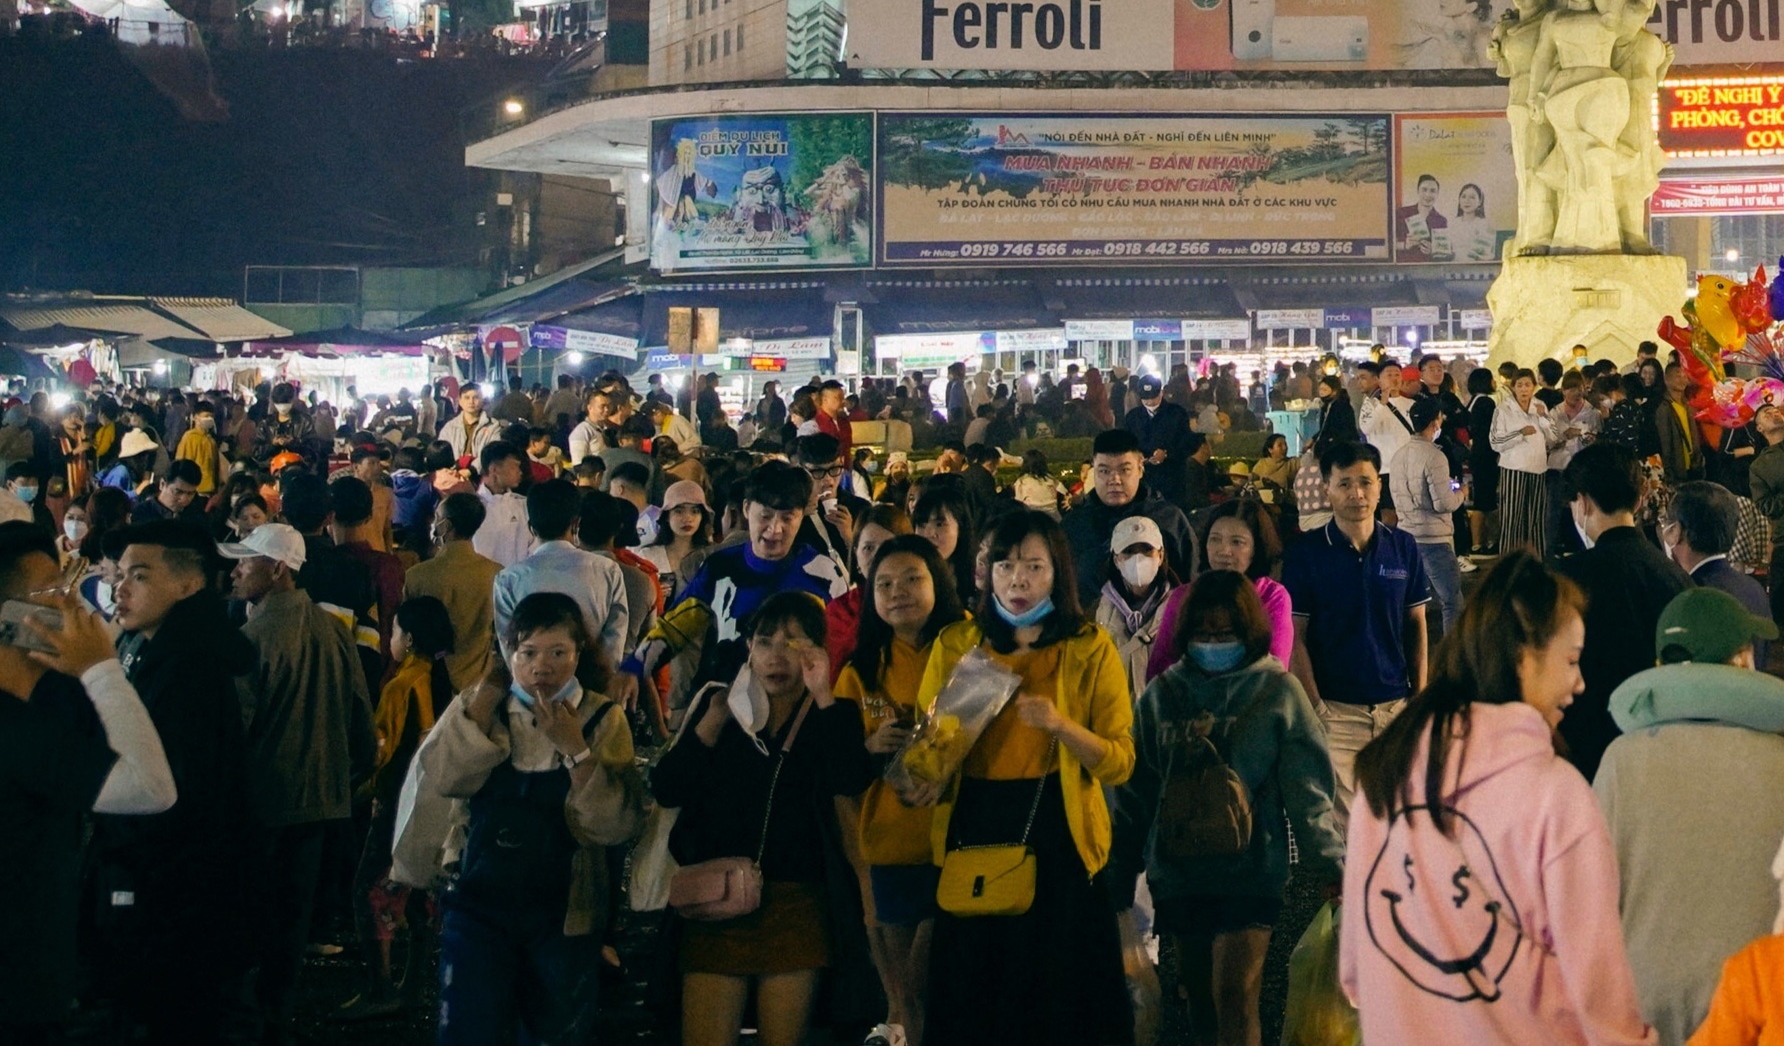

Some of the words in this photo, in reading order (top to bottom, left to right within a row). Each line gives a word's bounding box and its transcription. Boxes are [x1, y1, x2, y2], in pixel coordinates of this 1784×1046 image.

[731, 131, 748, 142] DU
[750, 130, 781, 143] LỊCH
[1038, 131, 1066, 142] "NÓI
[1069, 129, 1092, 142] ĐẾN
[1096, 130, 1120, 142] NHÀ
[1123, 129, 1146, 142] ĐẤT
[1188, 129, 1212, 142] ĐẾN
[1214, 130, 1239, 141] LIÊN
[1242, 132, 1277, 142] MINH"
[1004, 155, 1051, 170] MUA
[1055, 155, 1134, 171] NHANH
[1149, 152, 1195, 170] BÁN
[1197, 155, 1274, 170] NHANH
[937, 198, 959, 210] TẬP
[998, 196, 1037, 208] CHÚNG
[1039, 198, 1059, 208] TÔI
[1080, 199, 1104, 208] NHU
[1106, 196, 1130, 208] CẦU
[1133, 199, 1157, 207] MUA
[1159, 198, 1199, 207] NHANH
[1202, 197, 1226, 207] NHÀ
[1229, 195, 1249, 207] ĐẤT
[1265, 197, 1286, 207] CÁC
[1289, 198, 1311, 207] KHU
[1314, 198, 1337, 209] VỰC
[960, 243, 1000, 256] 0919
[1002, 243, 1034, 256] 746
[1036, 243, 1068, 255] 566
[1104, 243, 1142, 256] 0918
[1143, 242, 1178, 255] 442
[1180, 242, 1210, 254] 566
[1250, 242, 1288, 255] 0918
[1290, 242, 1321, 254] 439
[1323, 242, 1353, 254] 566
